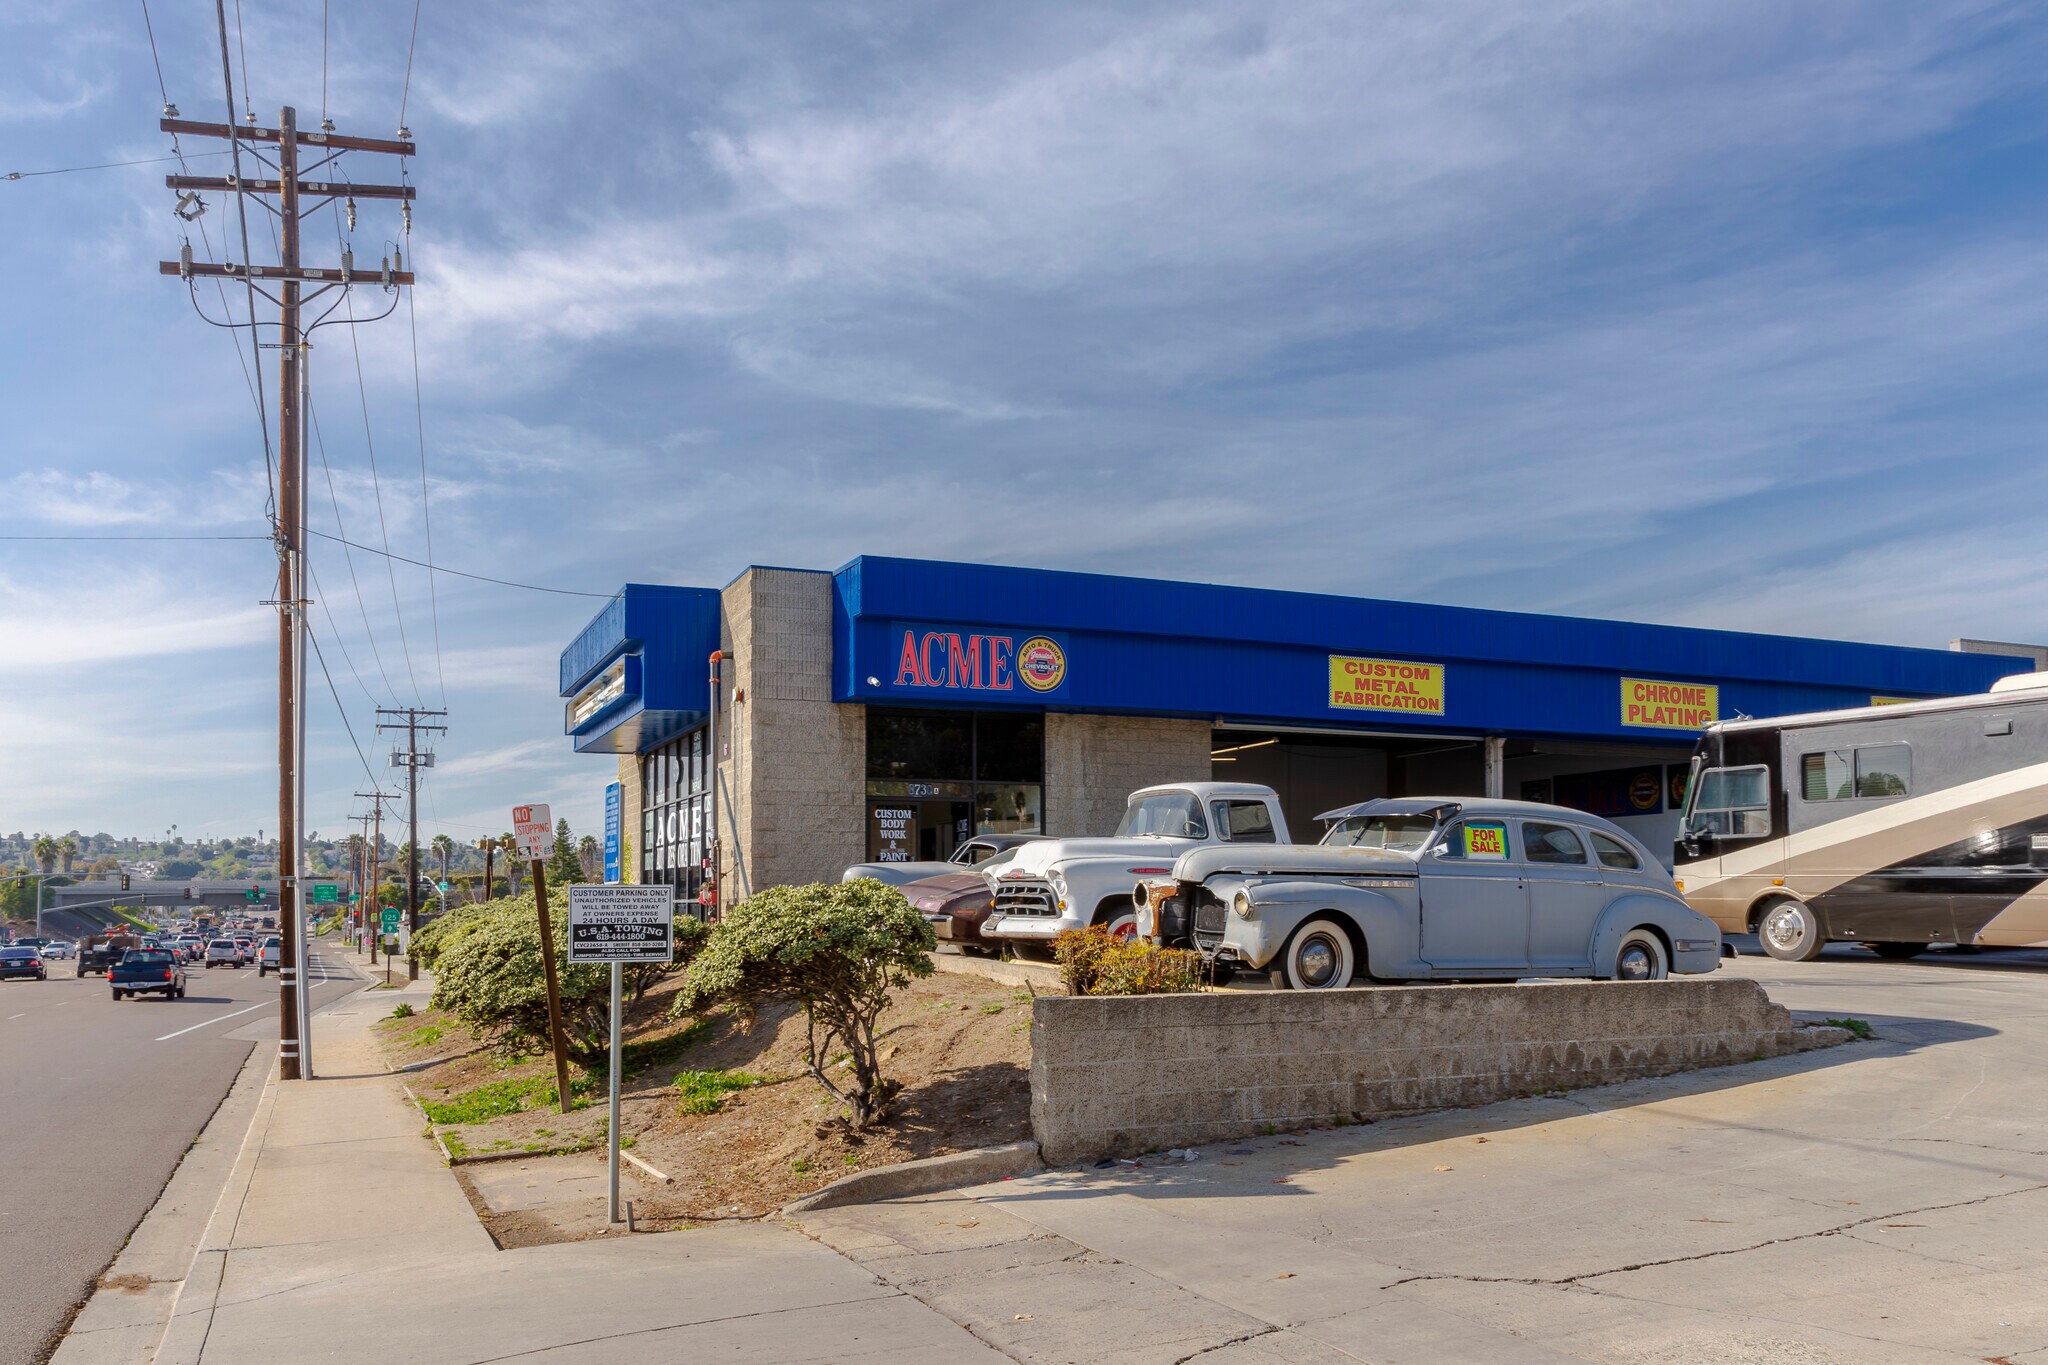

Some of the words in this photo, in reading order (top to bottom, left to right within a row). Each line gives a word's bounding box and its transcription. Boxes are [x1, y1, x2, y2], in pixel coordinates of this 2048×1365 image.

[1022, 642, 1036, 657] AUTO
[1044, 642, 1061, 661] TRUCK
[893, 630, 1013, 690] ACME
[1344, 662, 1430, 680] CUSTOM
[1355, 677, 1419, 694] METAL
[1334, 691, 1439, 710] FABRICATION
[1634, 683, 1706, 706] CHROME
[1628, 704, 1711, 726] PLATING
[515, 808, 528, 821] NO
[875, 809, 912, 818] CUSTOM
[517, 822, 549, 836] STOPPING
[656, 805, 702, 847] ACME
[880, 819, 906, 829] BODY
[880, 829, 906, 839] WORK
[1472, 829, 1496, 841] FOR
[889, 840, 896, 849] &
[1471, 841, 1500, 853] SALE
[880, 852, 908, 862] PAINT
[573, 889, 614, 897] CUSTOMER
[616, 889, 648, 897] PARKING
[578, 926, 613, 937] U.S.A.
[614, 925, 663, 936] TOWING
